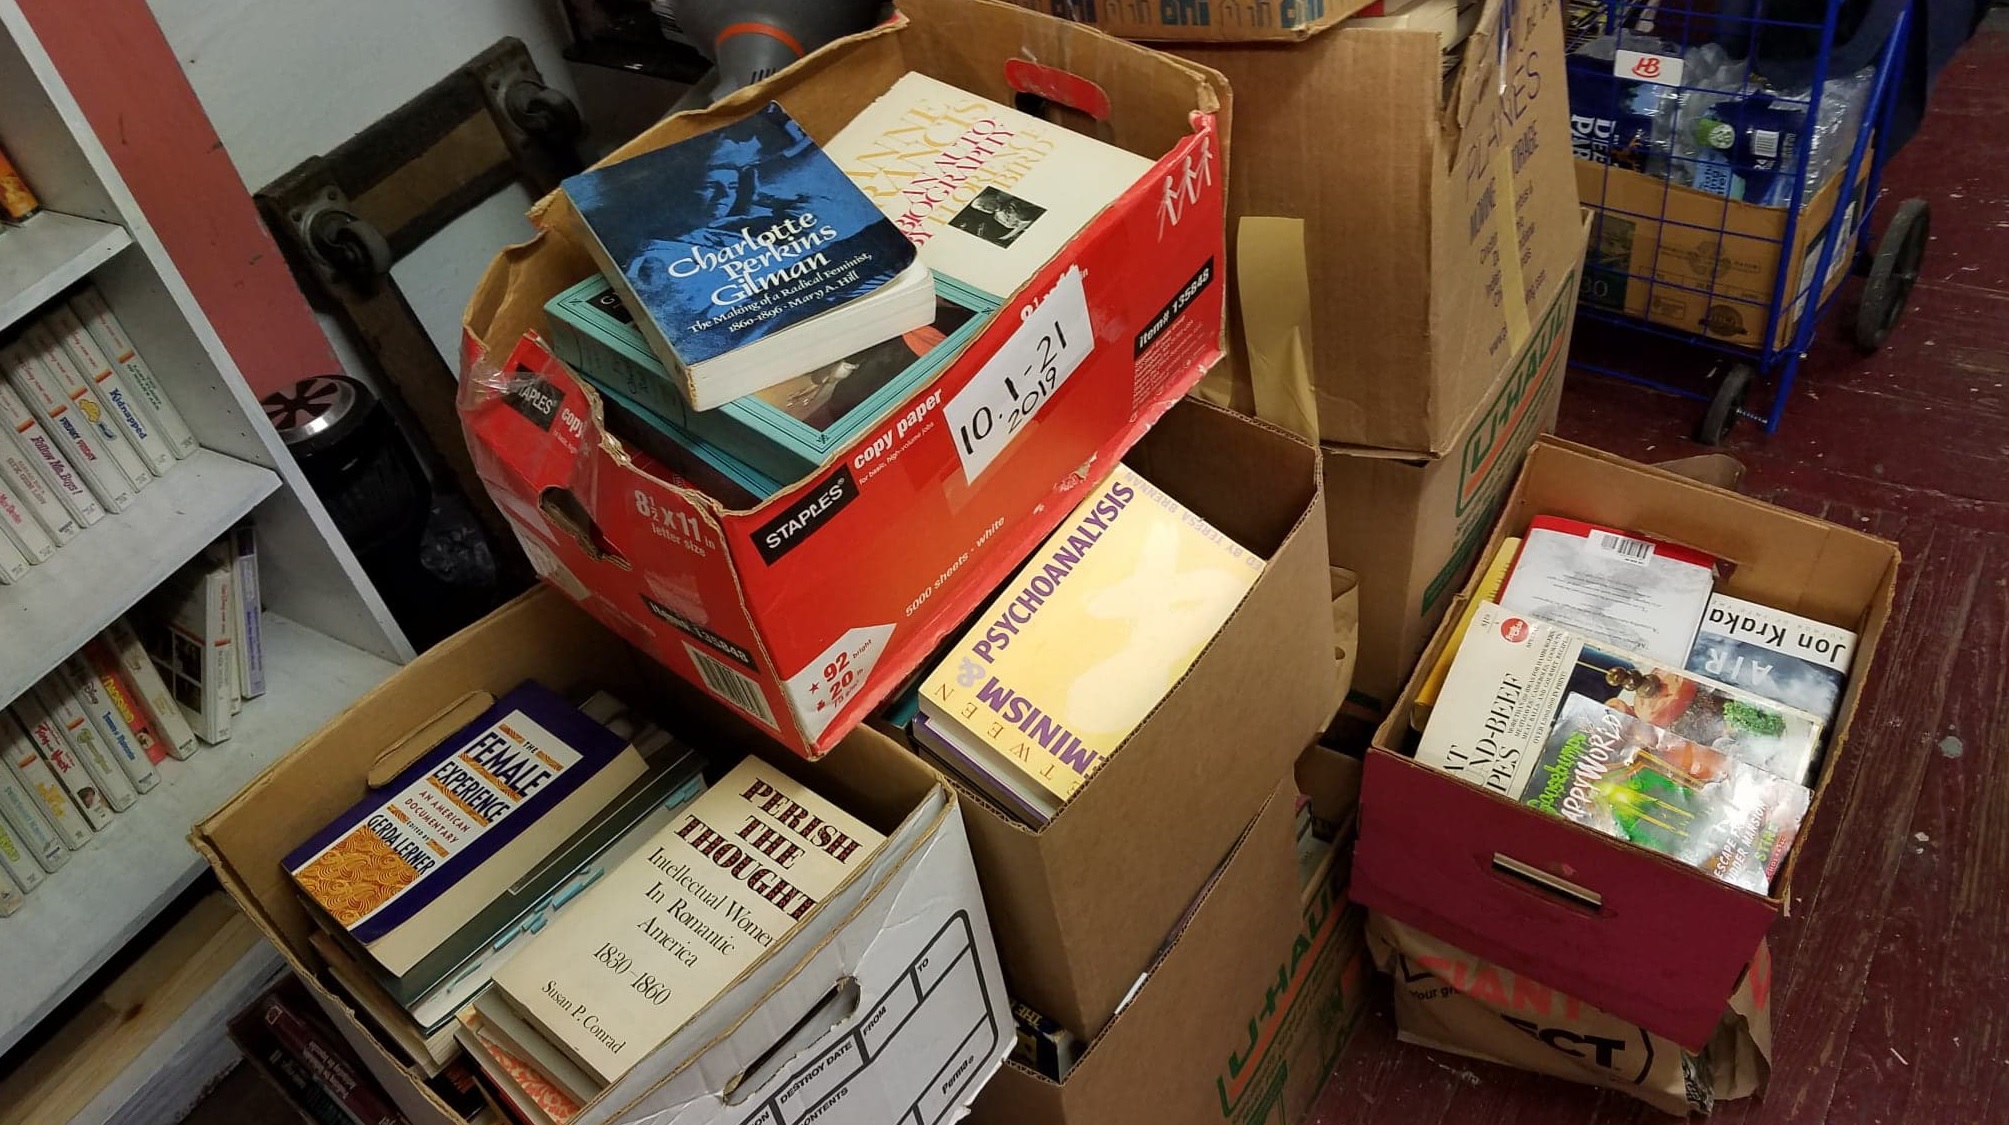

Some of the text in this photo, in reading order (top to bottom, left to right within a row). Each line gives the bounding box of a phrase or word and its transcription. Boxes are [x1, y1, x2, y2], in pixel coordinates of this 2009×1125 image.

[861, 100, 990, 209] RANCIS
[895, 127, 1016, 238] BIOGRAPHY
[901, 117, 1004, 199] AN AUTO
[667, 210, 818, 279] Charlotte
[719, 224, 838, 281] Perkins
[686, 316, 714, 335] The
[712, 300, 763, 327] Making
[781, 273, 823, 299] Radical
[822, 252, 874, 285] Feminist,
[710, 252, 832, 308] Gilman
[728, 271, 860, 335] 1860-1896 Mary A. Hill
[1171, 266, 1211, 315] 135848
[59, 416, 79, 441] FREAKY
[109, 389, 146, 438] Kidnapped
[514, 384, 586, 438] TAPLES copy
[853, 388, 944, 471] copy paper
[1006, 365, 1058, 435] 2019
[30, 433, 55, 462] Follow
[58, 470, 82, 498] Boys!
[765, 484, 844, 549] STAPLES
[904, 515, 1006, 618] 5000 sheets white
[971, 481, 1135, 665] PSYCHOANALYSIS
[823, 638, 872, 683] 92 bright
[1704, 647, 1774, 686] AIR
[1708, 608, 1847, 663] Jon Kraka
[829, 670, 854, 701] 20
[463, 731, 553, 801] FEMALE
[522, 739, 539, 755] THE
[1527, 731, 1587, 815] Goosebumps
[403, 797, 460, 845] DOCUMENTARY
[430, 798, 472, 834] AMERICAN
[431, 759, 513, 824] EXPERIENCE
[738, 777, 863, 865] PERISH
[366, 813, 437, 876] GERDA LERNER
[673, 813, 819, 922] THOUGHT
[733, 814, 806, 870] THE
[1713, 837, 1737, 880] ESCAPE
[645, 846, 729, 912] Intellectual
[636, 915, 699, 969] America
[644, 881, 737, 958] In Romantic
[917, 957, 930, 973] TO
[540, 979, 582, 1018] Susan
[582, 1014, 628, 1056] Conrad
[862, 1005, 888, 1037] FROM
[779, 1042, 853, 1105] DESTROY DATE
[799, 1087, 849, 1125] ONTENTS
